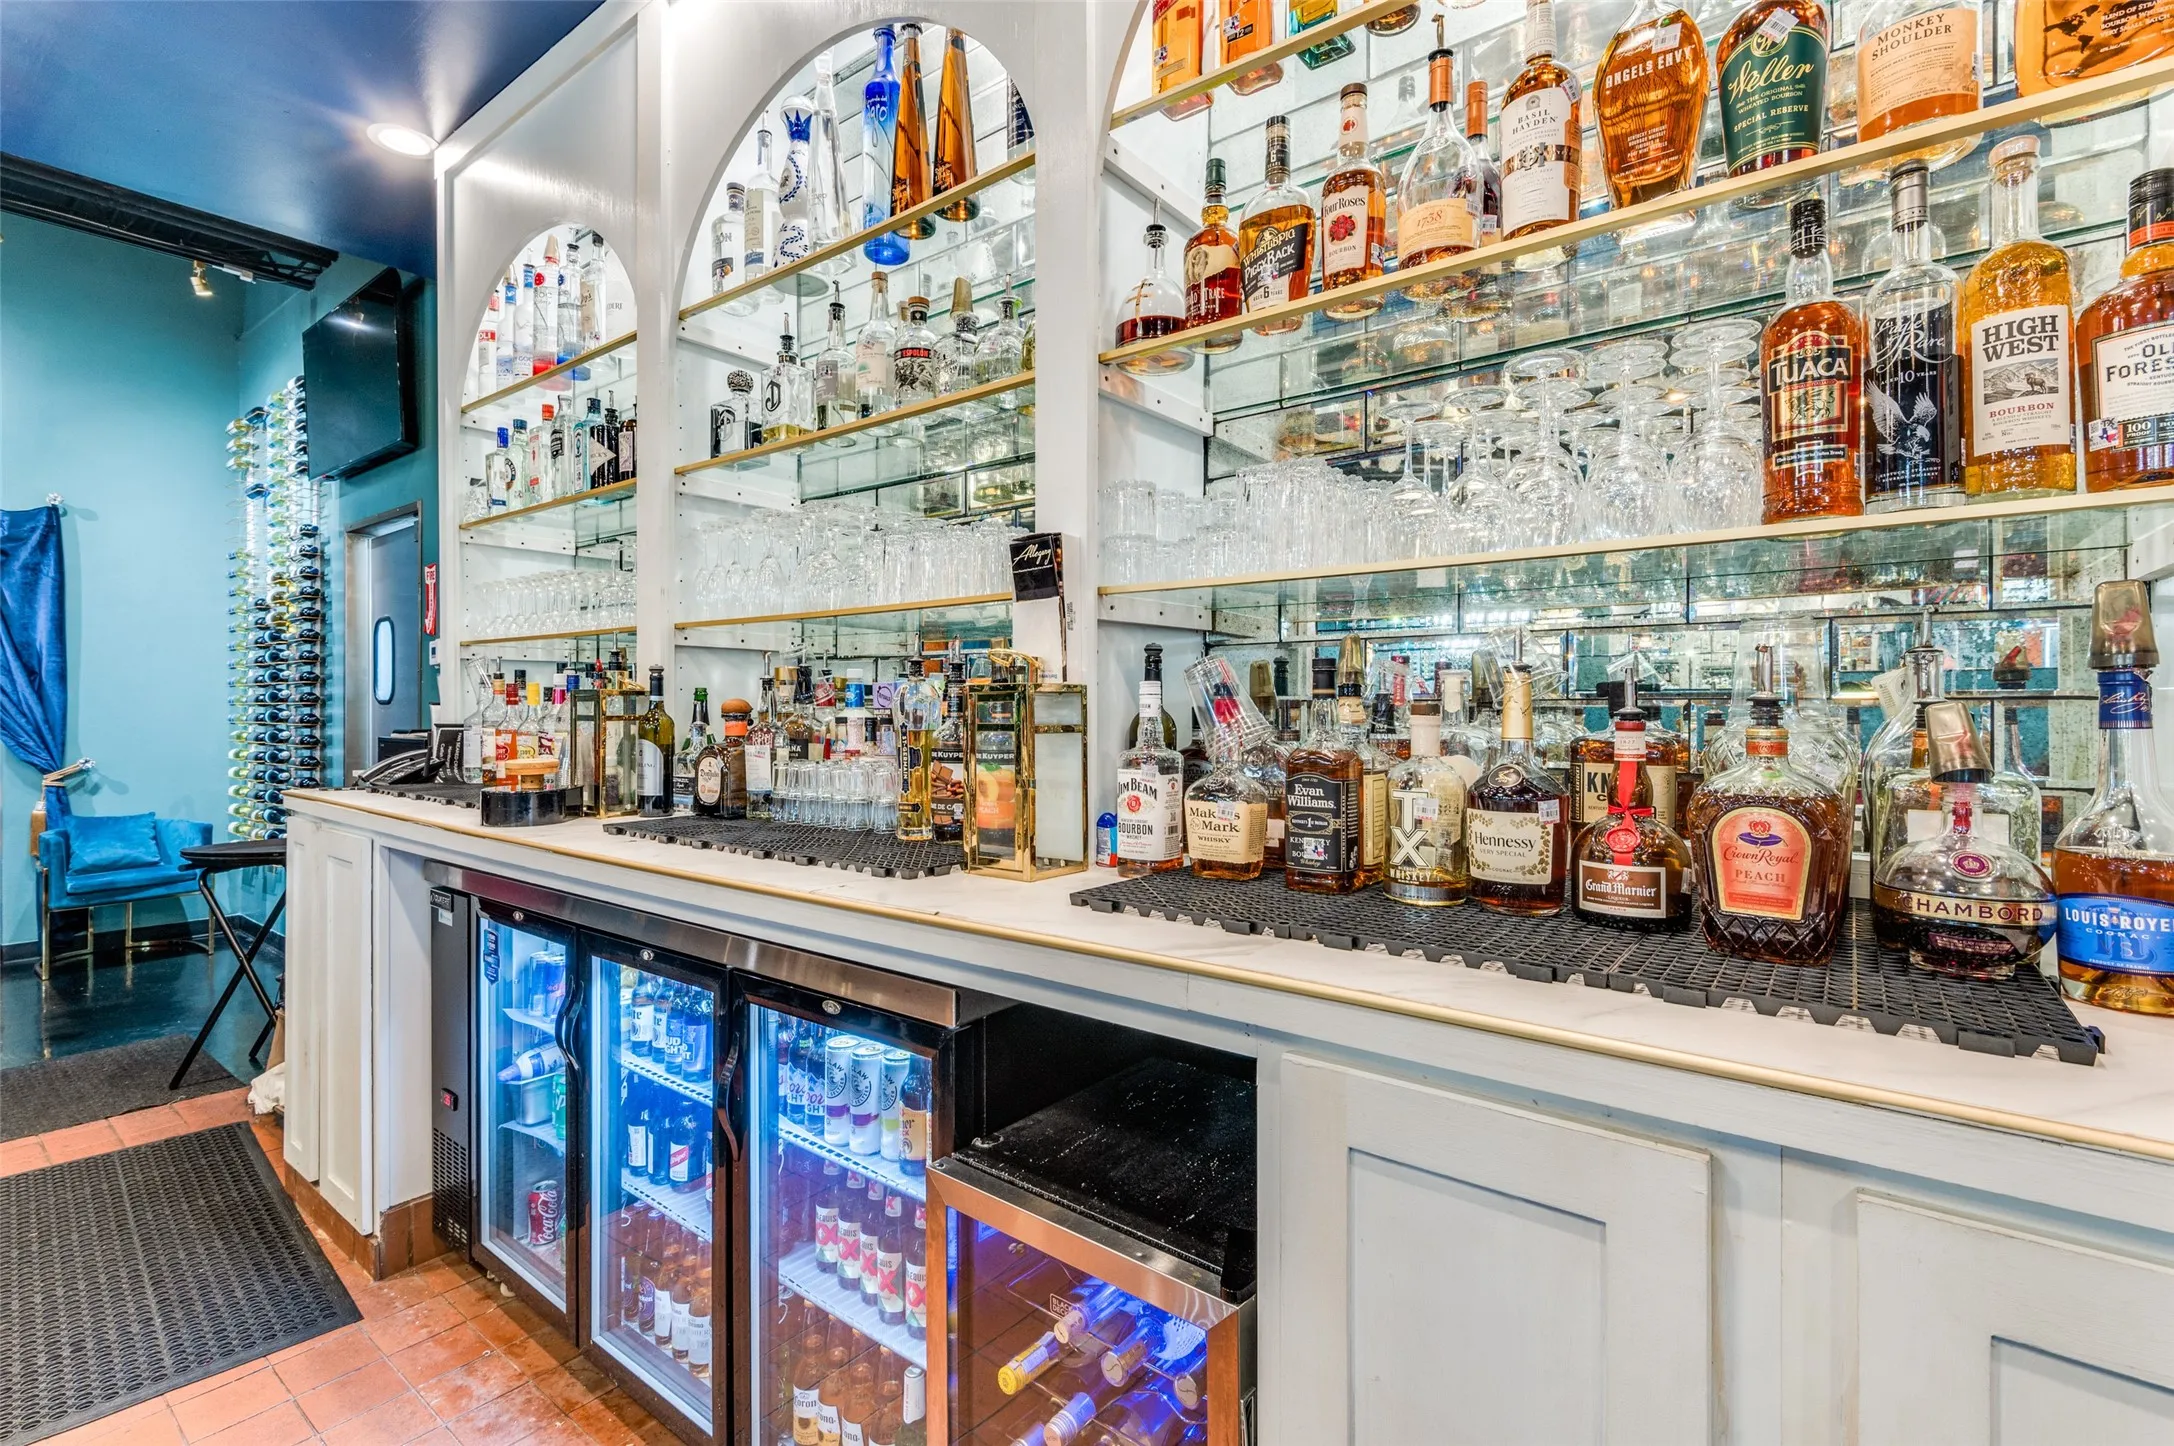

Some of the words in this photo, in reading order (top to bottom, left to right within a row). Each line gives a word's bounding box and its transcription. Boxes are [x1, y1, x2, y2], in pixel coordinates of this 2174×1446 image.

[1877, 13, 1945, 46] MONKEY
[1872, 24, 1952, 61] SHOULDER
[1605, 60, 1653, 89] ANGELS
[1658, 46, 1692, 70] ENVY
[1728, 54, 1814, 105] Weller
[1738, 98, 1769, 114] WHEATED
[1771, 90, 1803, 102] BOURBON
[1746, 94, 1760, 103] THE
[1761, 85, 1794, 97] ORIGINAL
[1518, 109, 1551, 124] BASIL
[1734, 113, 1767, 132] SPECIAL
[1770, 105, 1809, 116] RESERVE
[1512, 116, 1557, 135] HAYDEN
[1270, 151, 1277, 162] 6
[1339, 197, 1366, 209] Roses
[1416, 210, 1443, 228] 1738
[1263, 286, 1270, 299] 6
[1982, 314, 2059, 347] HIGH
[1983, 334, 2059, 363] WEST
[2142, 343, 2174, 358] OL
[1771, 357, 1849, 386] TUACA
[1899, 370, 1915, 384] 10
[1989, 402, 2055, 418] BOURBON
[2127, 421, 2151, 433] 100
[1118, 781, 1131, 797] JIM
[1131, 778, 1157, 802] BEAM
[1294, 783, 1325, 796] Evan
[1189, 807, 1240, 820] Maks
[1118, 822, 1153, 835] BOURBON
[1202, 820, 1240, 833] Mark
[1198, 835, 1231, 843] WHISKY
[1475, 831, 1537, 852] Hennessy
[1292, 850, 1328, 860] BOUN
[1496, 849, 1526, 857] SPECIAL
[1724, 845, 1758, 861] Crown
[1752, 848, 1799, 867] Royal
[1390, 868, 1431, 882] WHISKEY
[1735, 869, 1785, 882] PEACH
[1585, 878, 1612, 893] Grand
[1611, 882, 1657, 897] Marnier
[1902, 896, 2043, 922] CHAMBORD
[2065, 907, 2110, 928] LOUIS
[2120, 916, 2174, 932] ROYE
[2086, 928, 2150, 940] COGNAC
[793, 1395, 816, 1409] Coron
